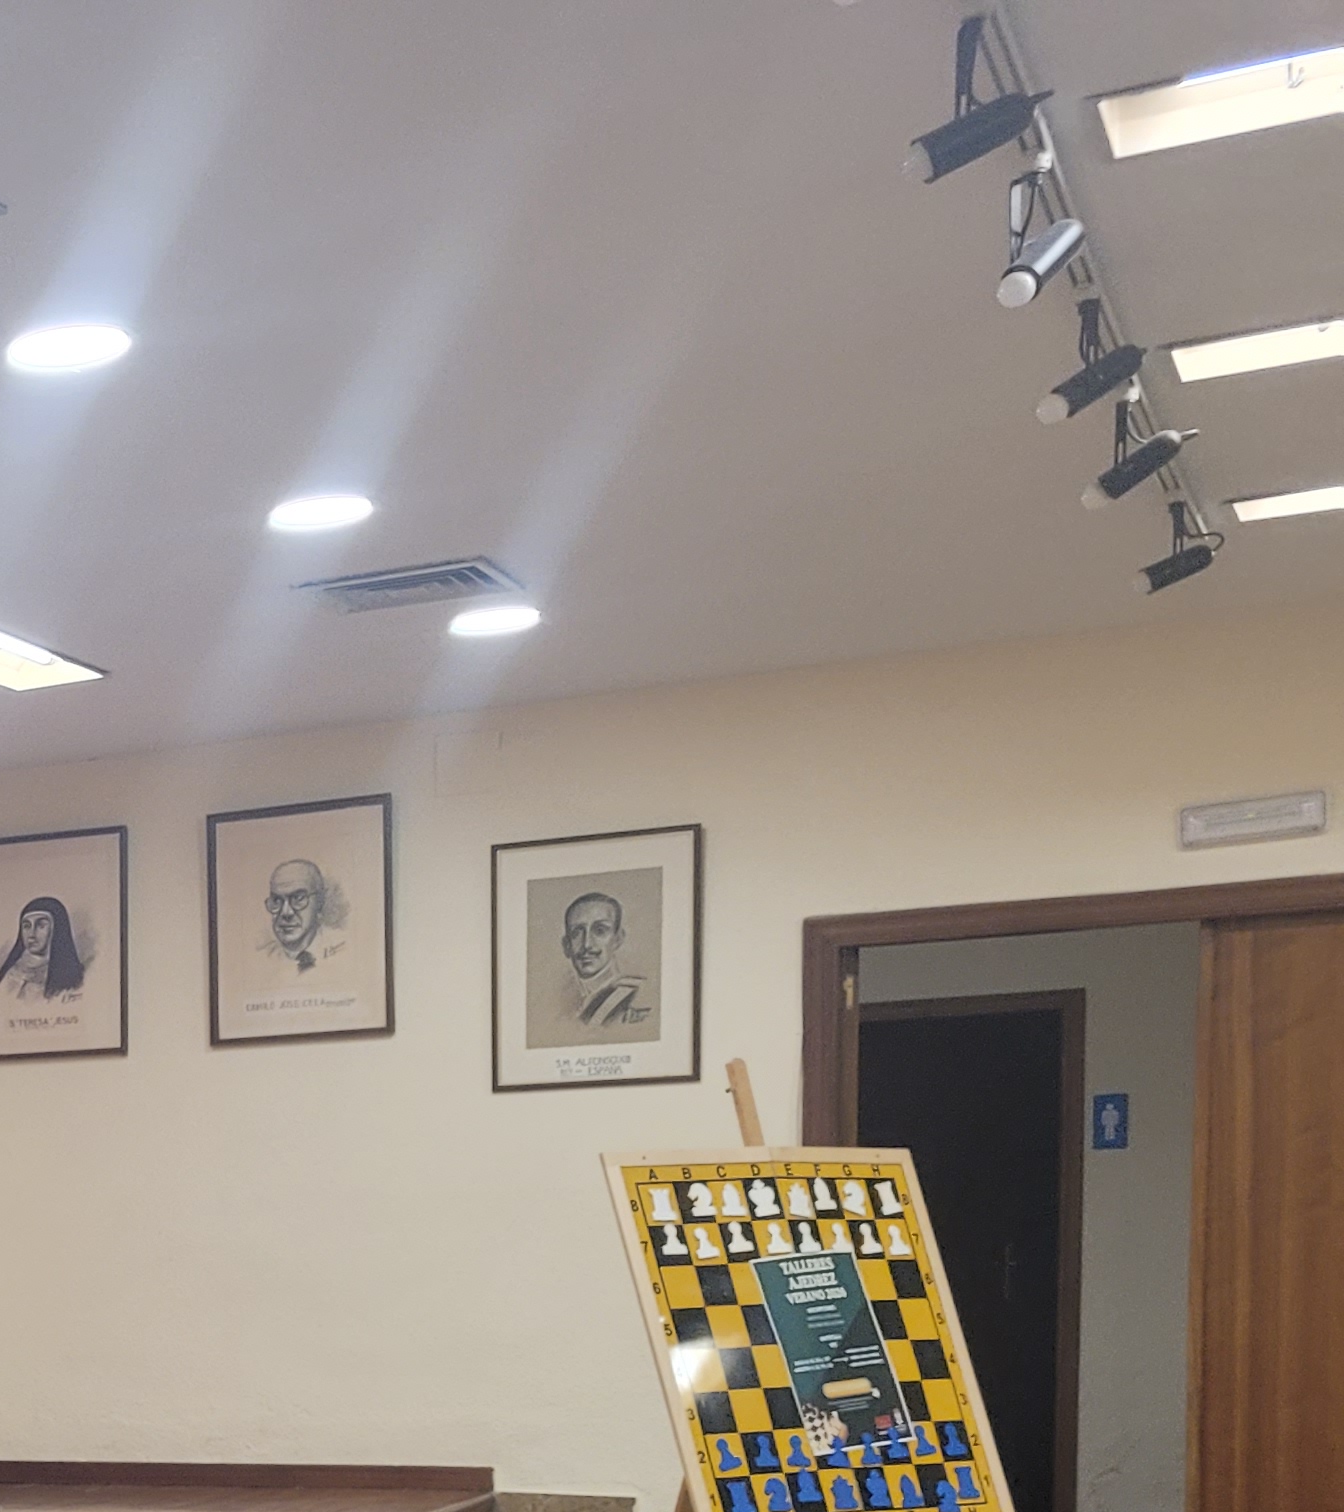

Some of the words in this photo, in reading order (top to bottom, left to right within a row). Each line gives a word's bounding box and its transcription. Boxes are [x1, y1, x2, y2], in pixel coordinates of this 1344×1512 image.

[649, 1168, 659, 1180] A
[682, 1167, 692, 1180] B
[716, 1165, 727, 1178] C
[751, 1164, 761, 1176] D
[784, 1163, 794, 1176] E
[842, 1164, 852, 1176] G
[871, 1164, 881, 1177] H
[630, 1199, 640, 1212] 8
[911, 1233, 919, 1245] 7
[640, 1240, 649, 1254] 7
[652, 1282, 661, 1295] 6
[664, 1323, 673, 1336] 5
[960, 1393, 968, 1406] 3
[686, 1408, 696, 1421] 3
[970, 1433, 980, 1447] 2
[697, 1450, 707, 1464] 2
[709, 1494, 717, 1506] 1
